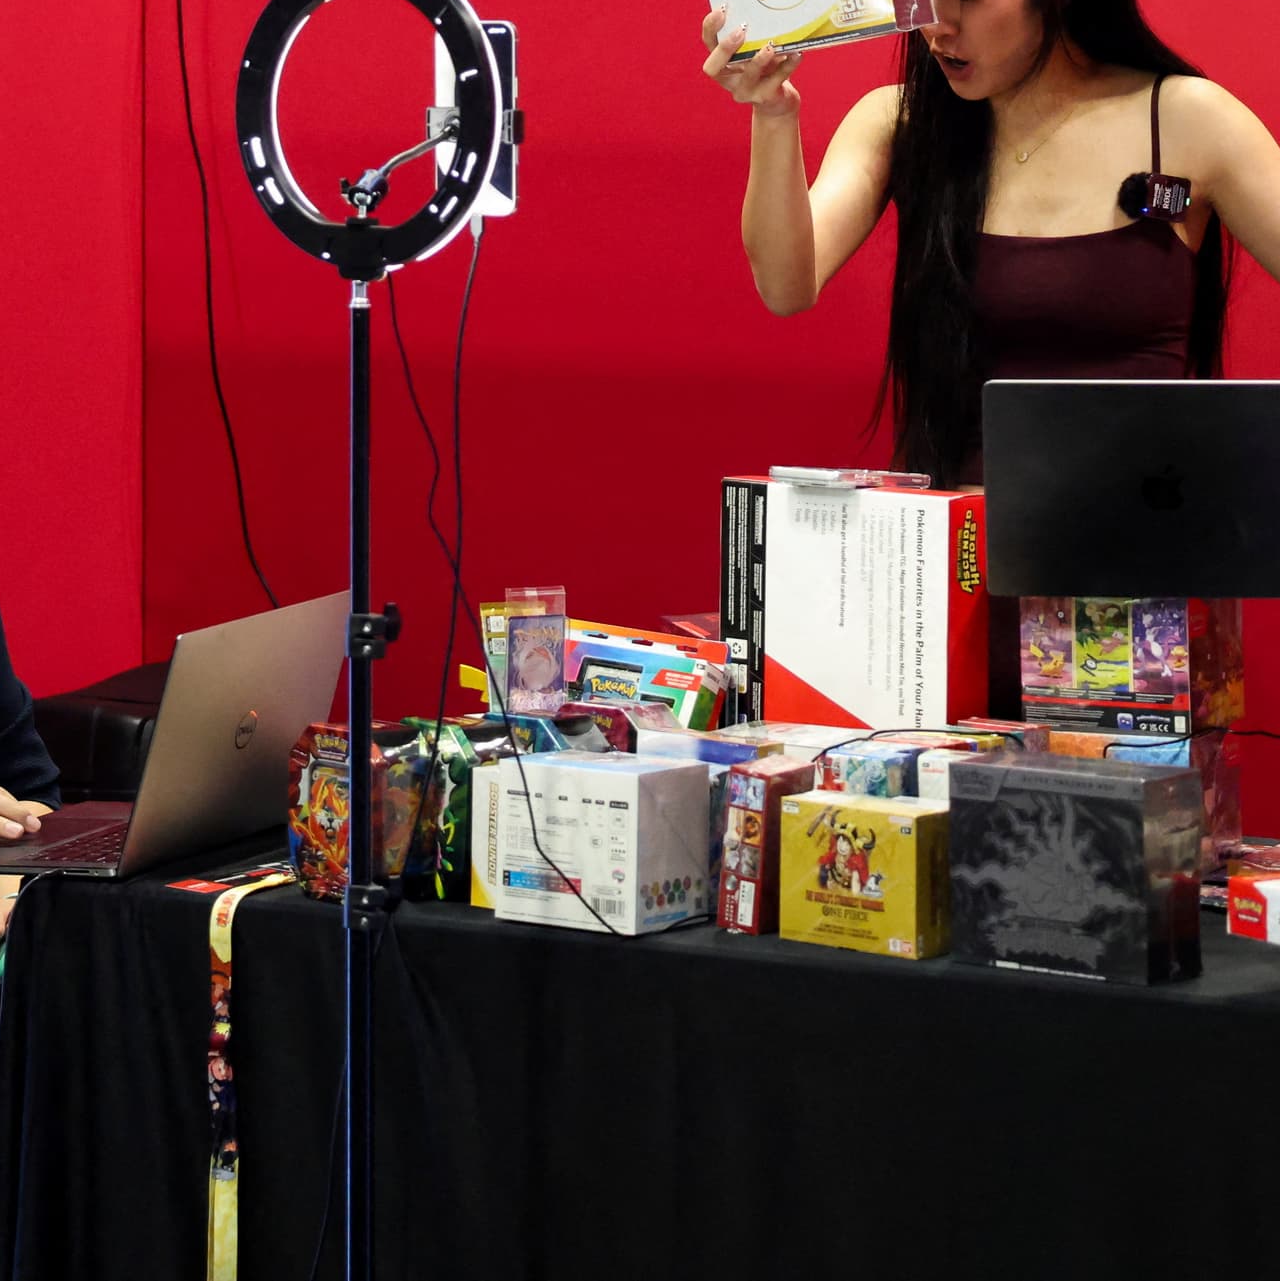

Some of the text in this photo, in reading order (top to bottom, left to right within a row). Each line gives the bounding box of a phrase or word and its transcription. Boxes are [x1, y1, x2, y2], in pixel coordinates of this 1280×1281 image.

[915, 559, 925, 607] Favorites
[915, 609, 924, 619] in
[915, 621, 924, 638] the
[915, 640, 924, 666] Palm
[915, 668, 924, 679] of
[915, 681, 924, 705] Your
